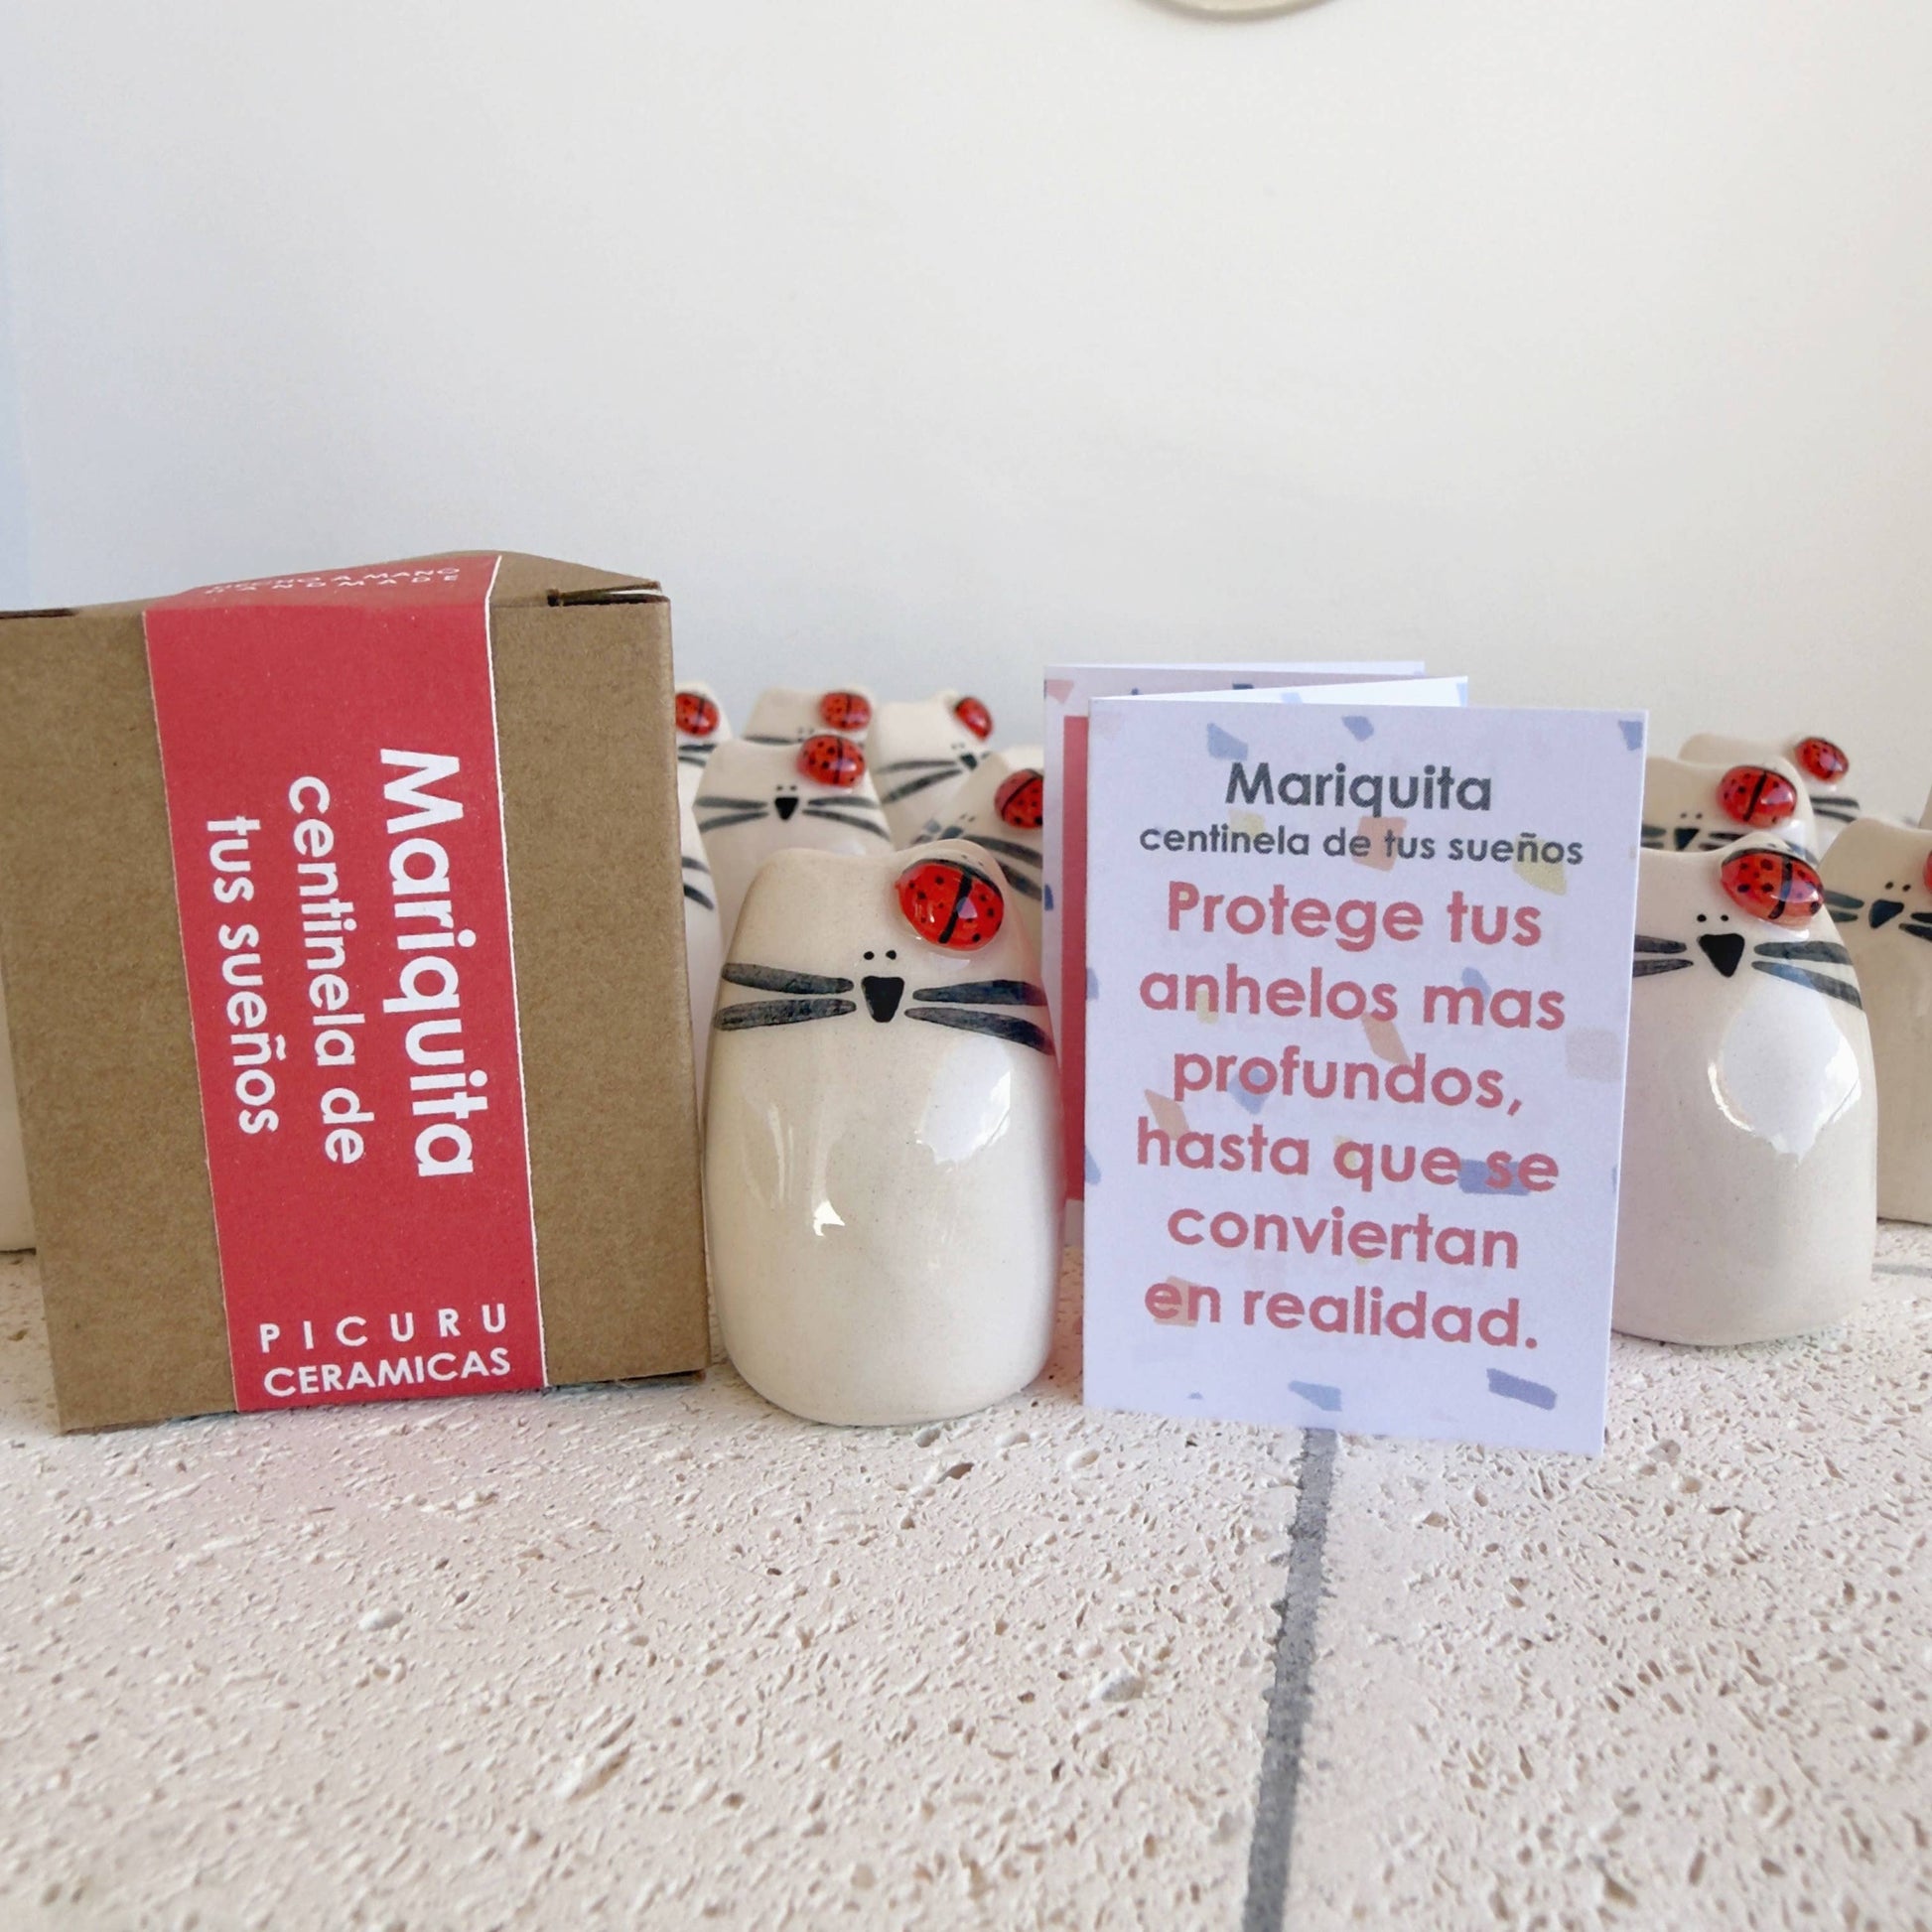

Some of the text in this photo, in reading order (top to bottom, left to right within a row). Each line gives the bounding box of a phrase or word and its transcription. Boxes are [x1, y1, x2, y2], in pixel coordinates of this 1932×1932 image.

[1225, 761, 1491, 819] Mariquita
[1140, 823, 1584, 866] centinela de tus sueños
[1168, 881, 1542, 952] Protege tus
[207, 815, 287, 1135] tus sueños
[289, 776, 375, 1165] centinela de
[380, 749, 488, 1177] Mariquita
[1140, 964, 1566, 1031] anhelos mas
[1173, 1045, 1523, 1116] profundos,
[1138, 1116, 1559, 1192] hasta que se
[1168, 1207, 1518, 1269] conviertan
[259, 1303, 506, 1353] PICURU
[1145, 1283, 1538, 1349] en realidad.
[263, 1347, 510, 1397] CERAMICAS
